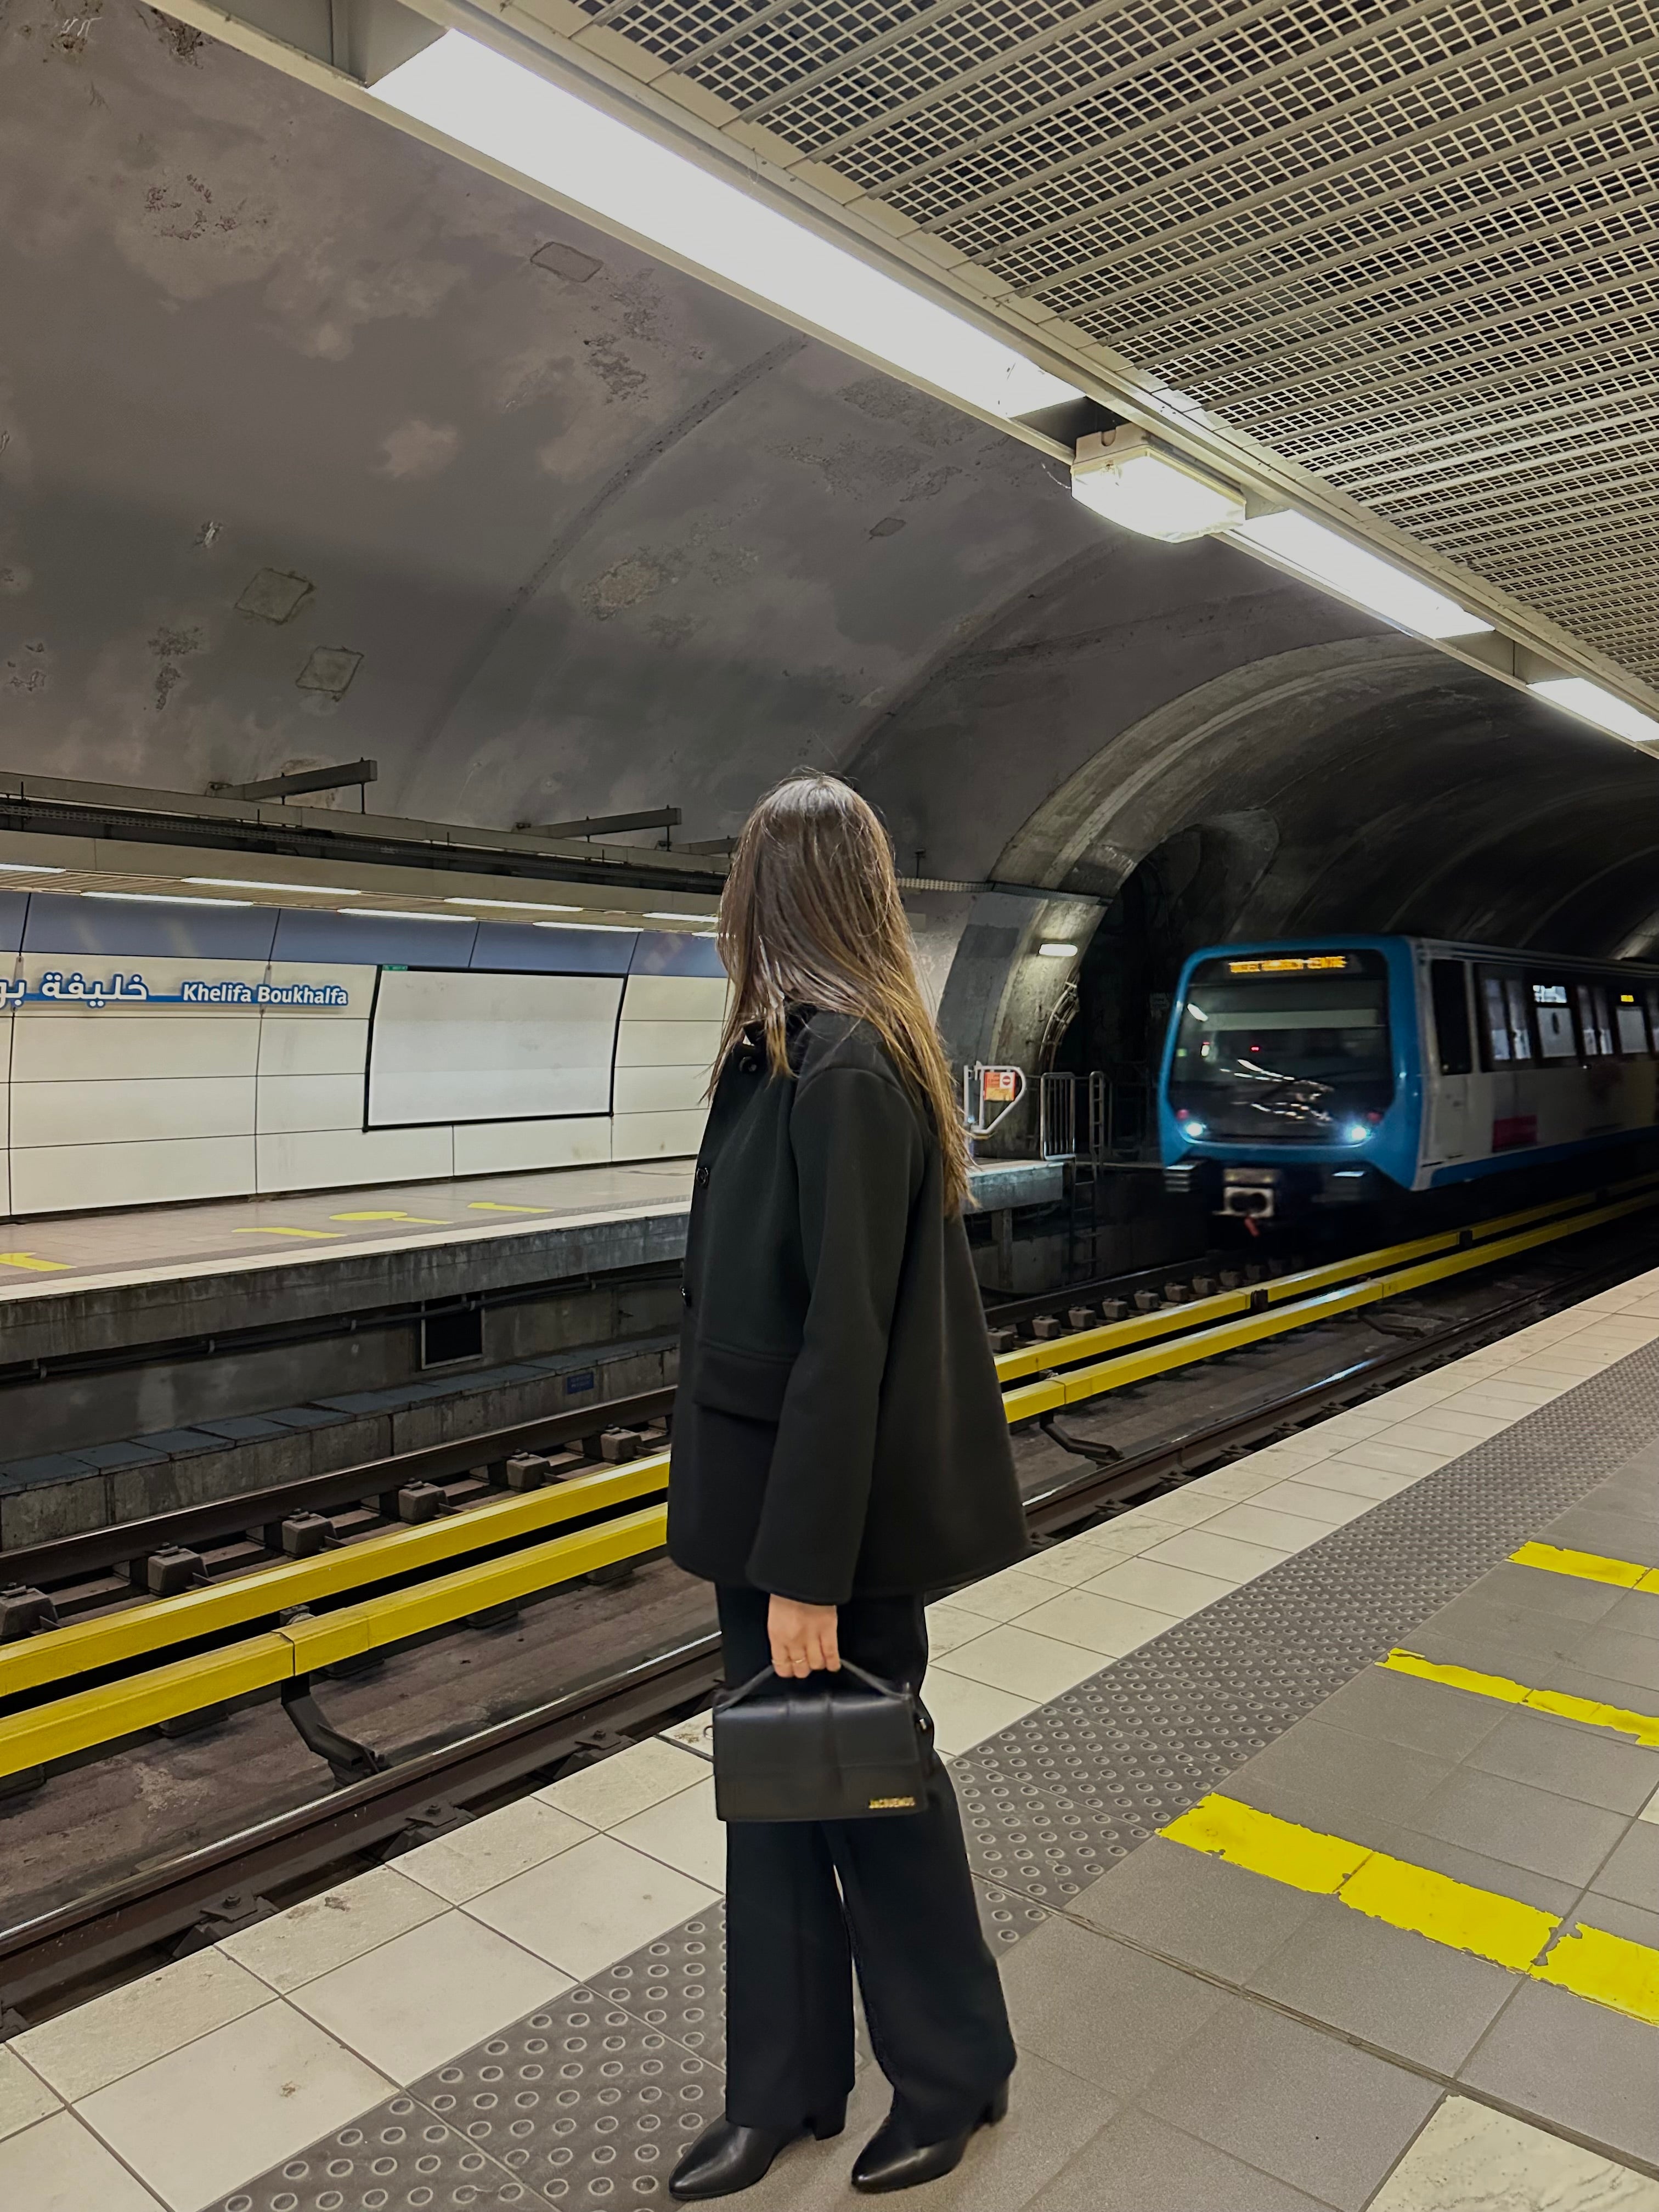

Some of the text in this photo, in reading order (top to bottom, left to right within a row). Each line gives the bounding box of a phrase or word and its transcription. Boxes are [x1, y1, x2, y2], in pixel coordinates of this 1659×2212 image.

[42, 974, 148, 1007] خليفة
[183, 984, 347, 1005] Khelifa Boukhalfa
